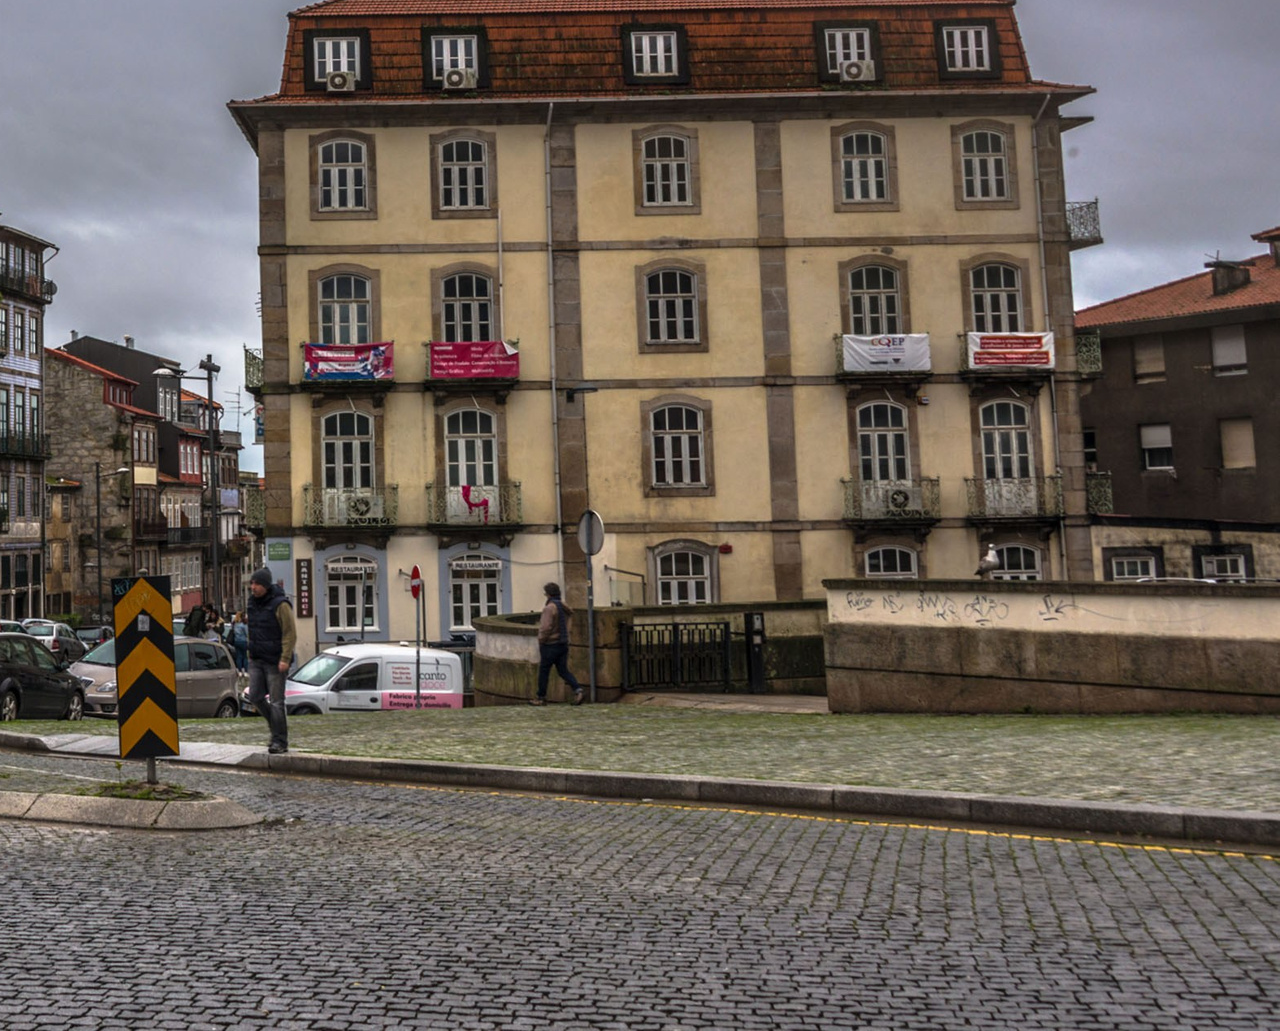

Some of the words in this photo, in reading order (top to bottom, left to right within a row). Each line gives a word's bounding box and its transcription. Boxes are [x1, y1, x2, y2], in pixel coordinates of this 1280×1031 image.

[871, 337, 905, 347] CQEP
[419, 671, 447, 680] canto
[420, 681, 446, 689] doce
[389, 700, 413, 708] Entrega
